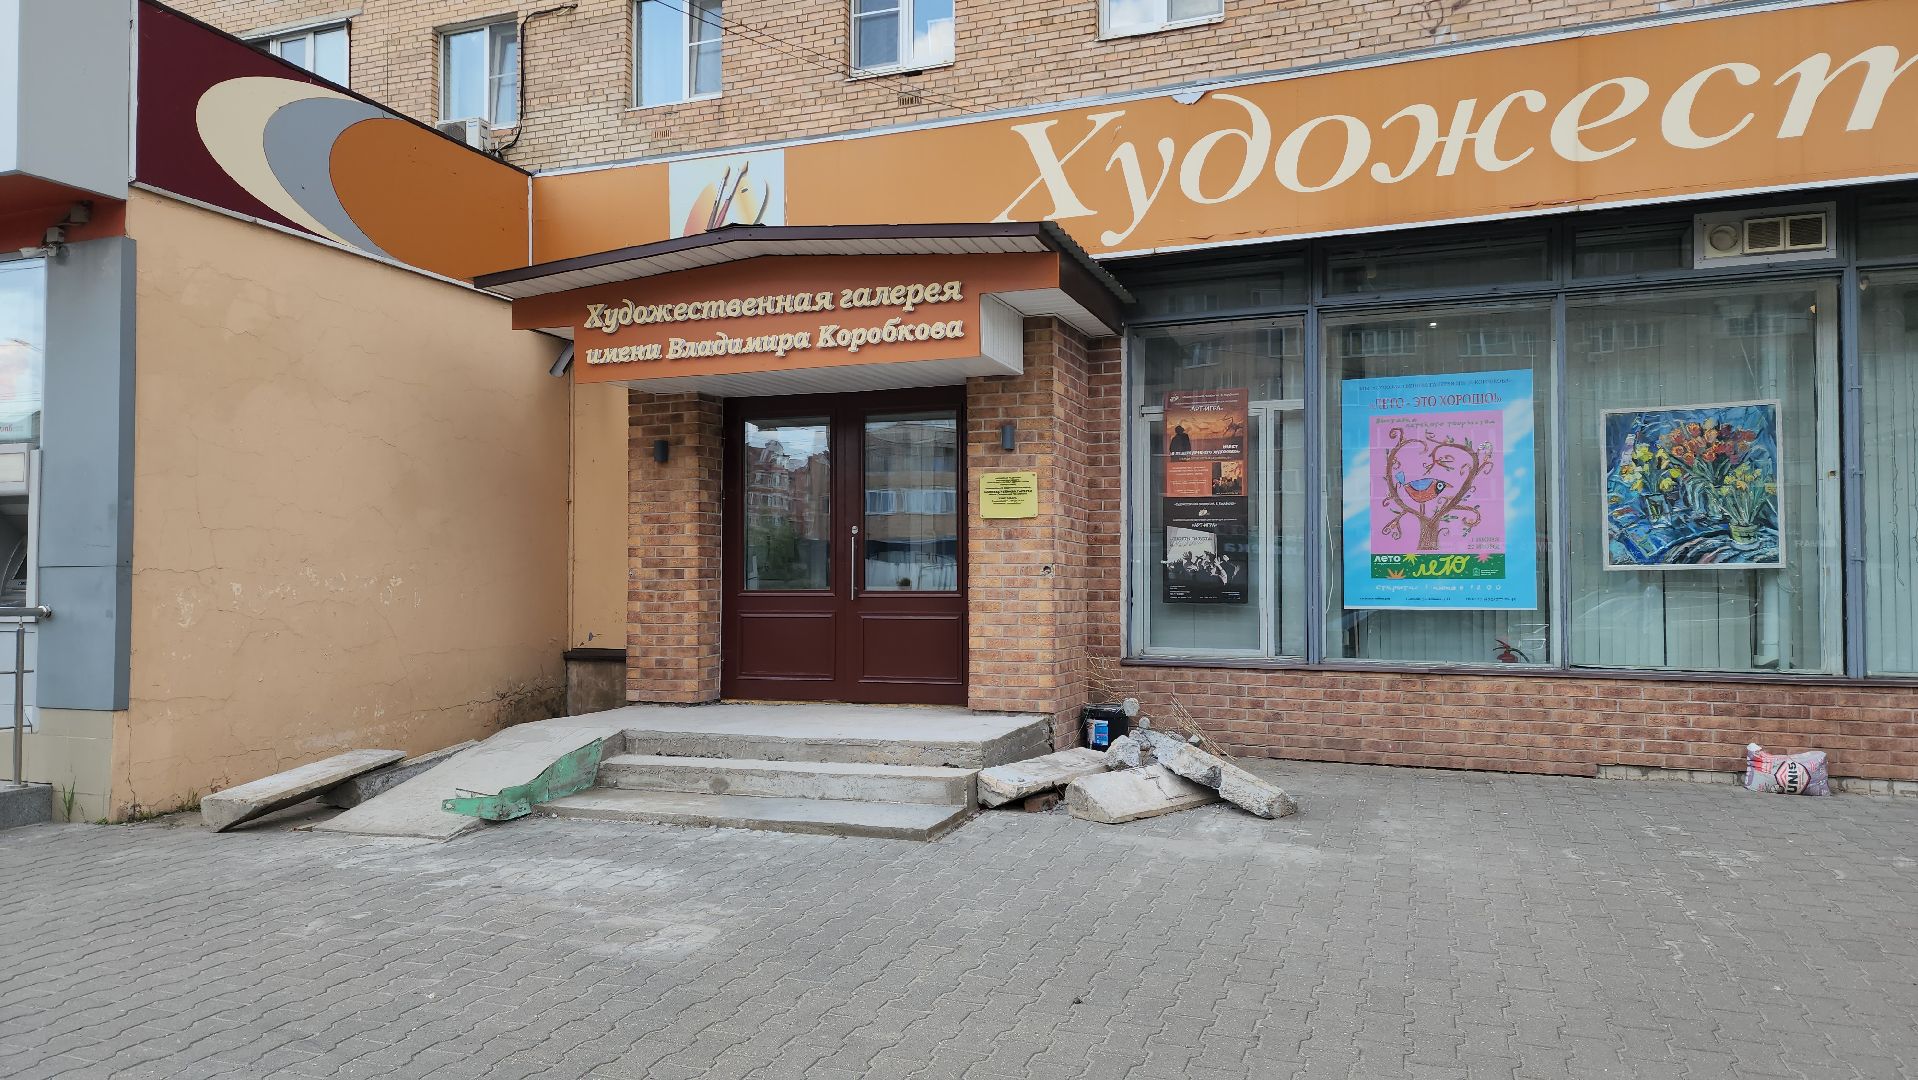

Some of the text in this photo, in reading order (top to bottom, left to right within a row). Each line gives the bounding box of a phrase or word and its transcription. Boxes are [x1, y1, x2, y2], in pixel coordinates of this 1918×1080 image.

[583, 281, 963, 333] Художественная галерея
[586, 317, 964, 365] имени Владимира Коробкова
[1413, 395, 1436, 408] ЭТО
[1787, 762, 1798, 793] UNIS
